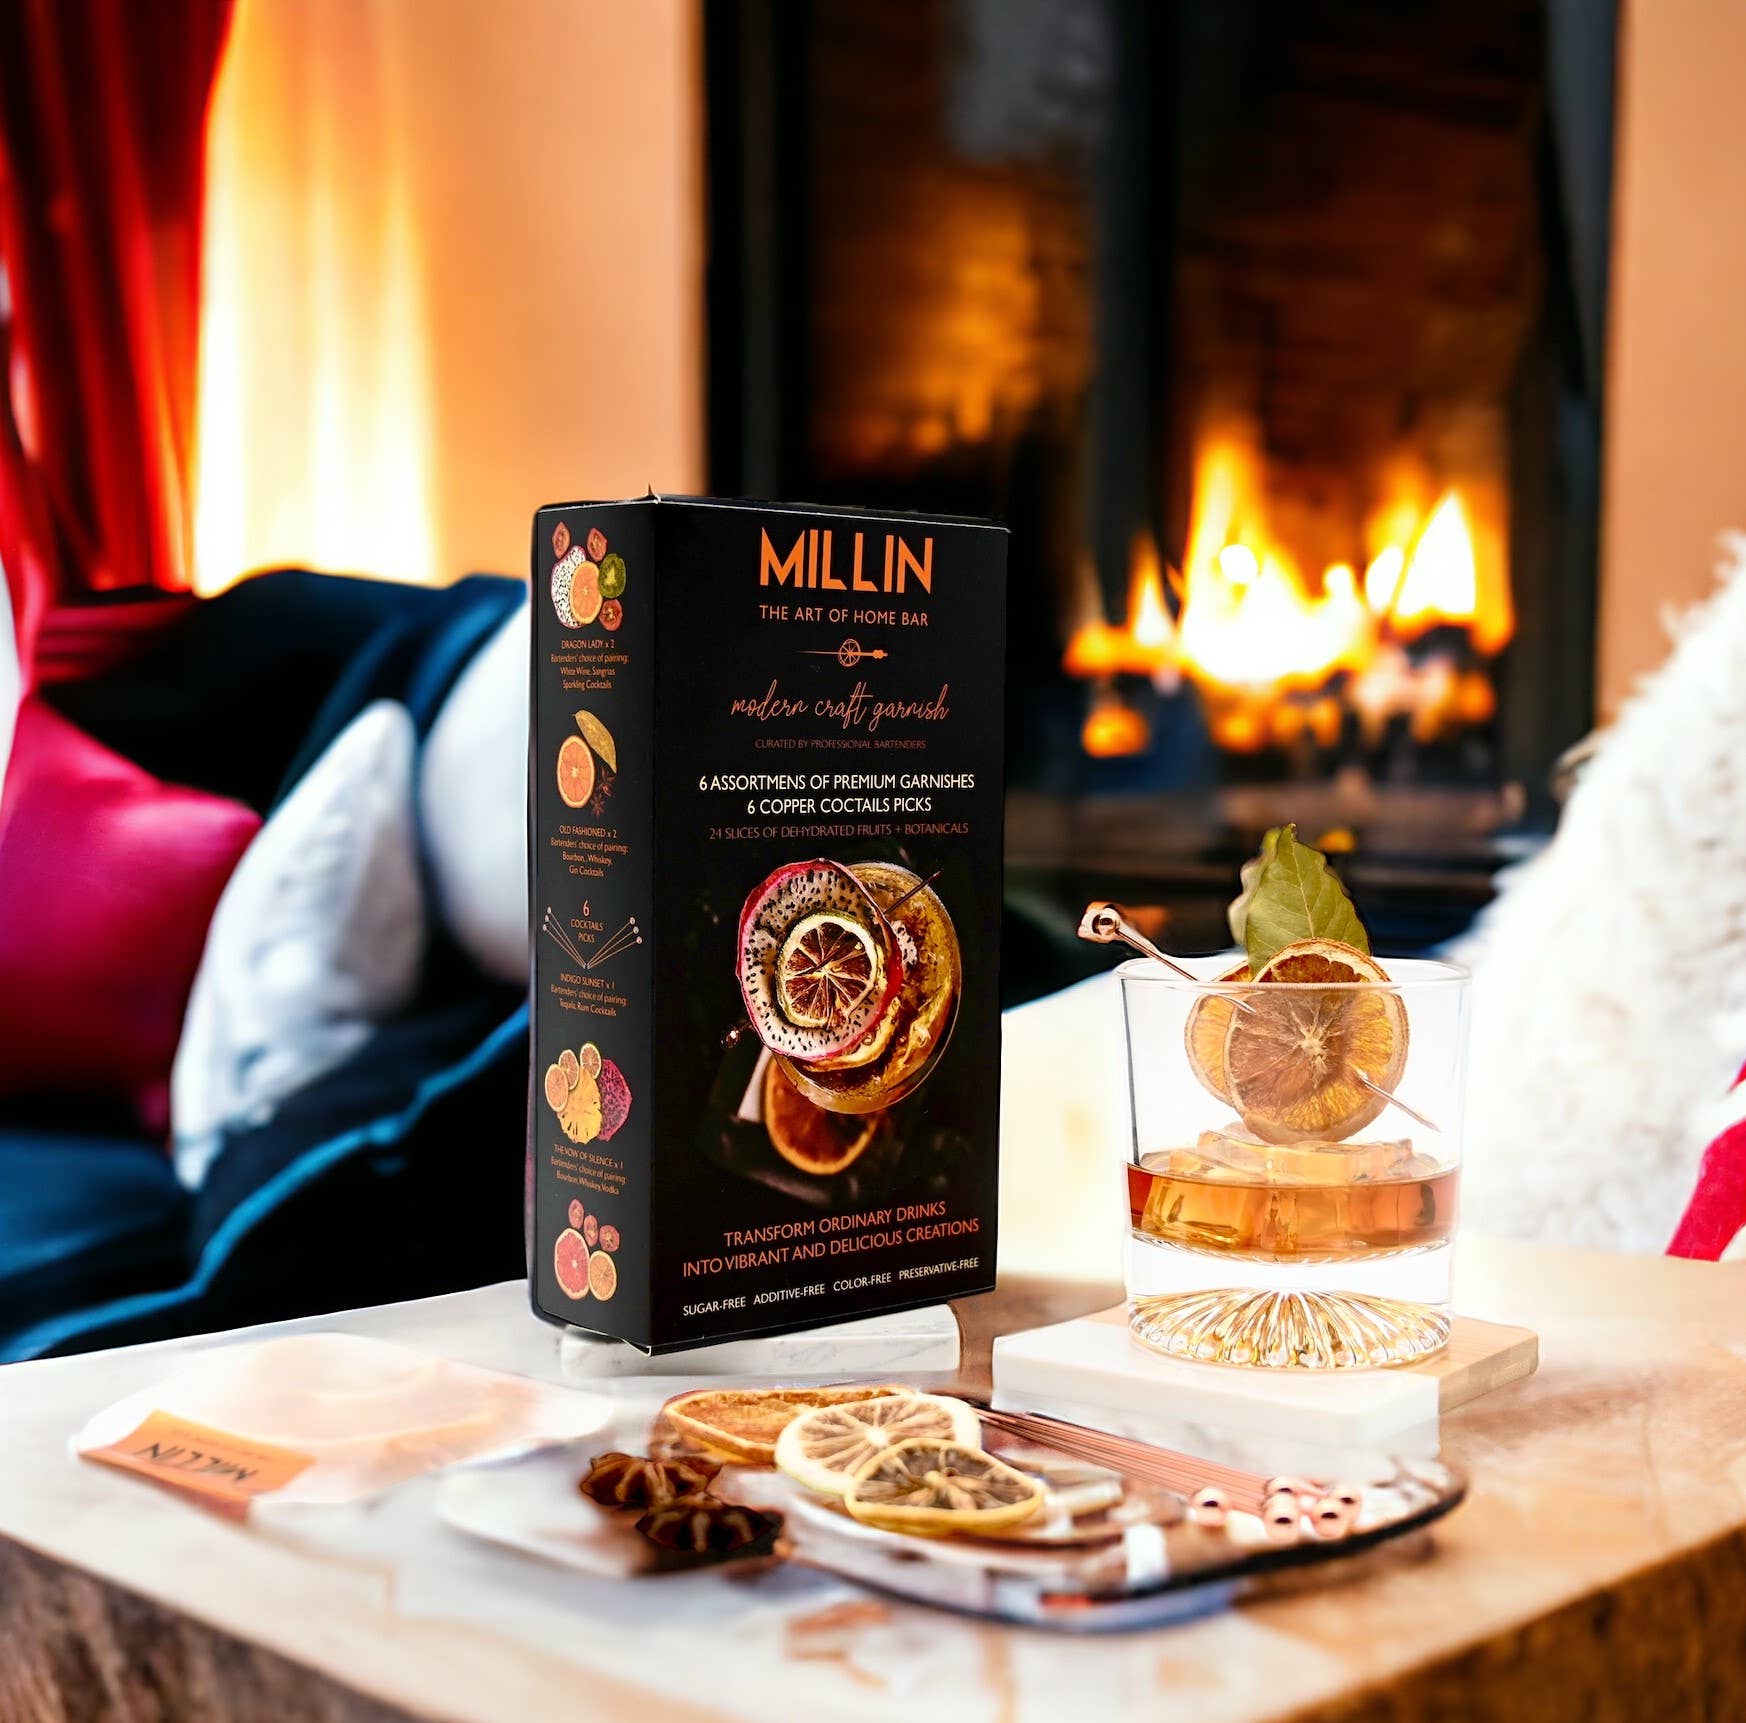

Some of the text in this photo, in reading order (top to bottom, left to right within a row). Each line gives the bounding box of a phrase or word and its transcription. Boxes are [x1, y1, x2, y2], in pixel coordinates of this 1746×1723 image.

[759, 526, 934, 594] MILLIN
[759, 605, 929, 627] THE ART OF HOME BAR
[561, 640, 587, 649] DRAGON
[588, 640, 603, 649] LADY
[611, 640, 615, 649] 2
[597, 654, 604, 662] of
[586, 680, 612, 689] Cocktails
[730, 679, 949, 732] modern craft garnish
[755, 739, 927, 750] CURATED BY PROFESSIONAL BARTENDERS
[699, 774, 975, 791] 6 ASSORTMENS OF PREMIUM GARNISHES
[747, 797, 932, 815] 6 COPPER COCTAILS PICKS
[560, 825, 571, 834] OLD
[572, 826, 606, 837] FASHIONED
[613, 829, 617, 838] 2
[709, 828, 722, 840] 24
[724, 827, 760, 839] SLICES
[763, 826, 779, 838] OF
[780, 825, 854, 837] DEHYDRATED
[857, 825, 892, 836] FRUITS
[904, 823, 969, 835] BOTANICALS
[579, 842, 596, 850] choice
[597, 843, 604, 851] of
[569, 865, 604, 877] Gin Cocktails
[583, 900, 590, 916] 6
[570, 919, 604, 932] COCKTAILS
[578, 932, 595, 943] PICKS
[560, 974, 581, 985] INDIGO
[582, 976, 605, 989] SUNSET
[578, 989, 596, 1001] choice
[597, 993, 604, 1001] of
[590, 1004, 617, 1017] Cocktails
[554, 1144, 565, 1154] THE
[564, 1146, 578, 1158] VOW
[580, 1152, 588, 1160] OF
[589, 1154, 613, 1167] SILENCE
[579, 1164, 596, 1176] choice
[597, 1169, 604, 1177] of
[724, 1200, 946, 1248] TRANSFORM ORDINARY DRINKS
[683, 1218, 979, 1277] INTO VIBRANT AND DELICIOUS CREATIONS
[683, 1257, 979, 1316] SUGAR-FREE ADDITIVE-FREE COLOR-FREE PRESERVATIVE-FREE
